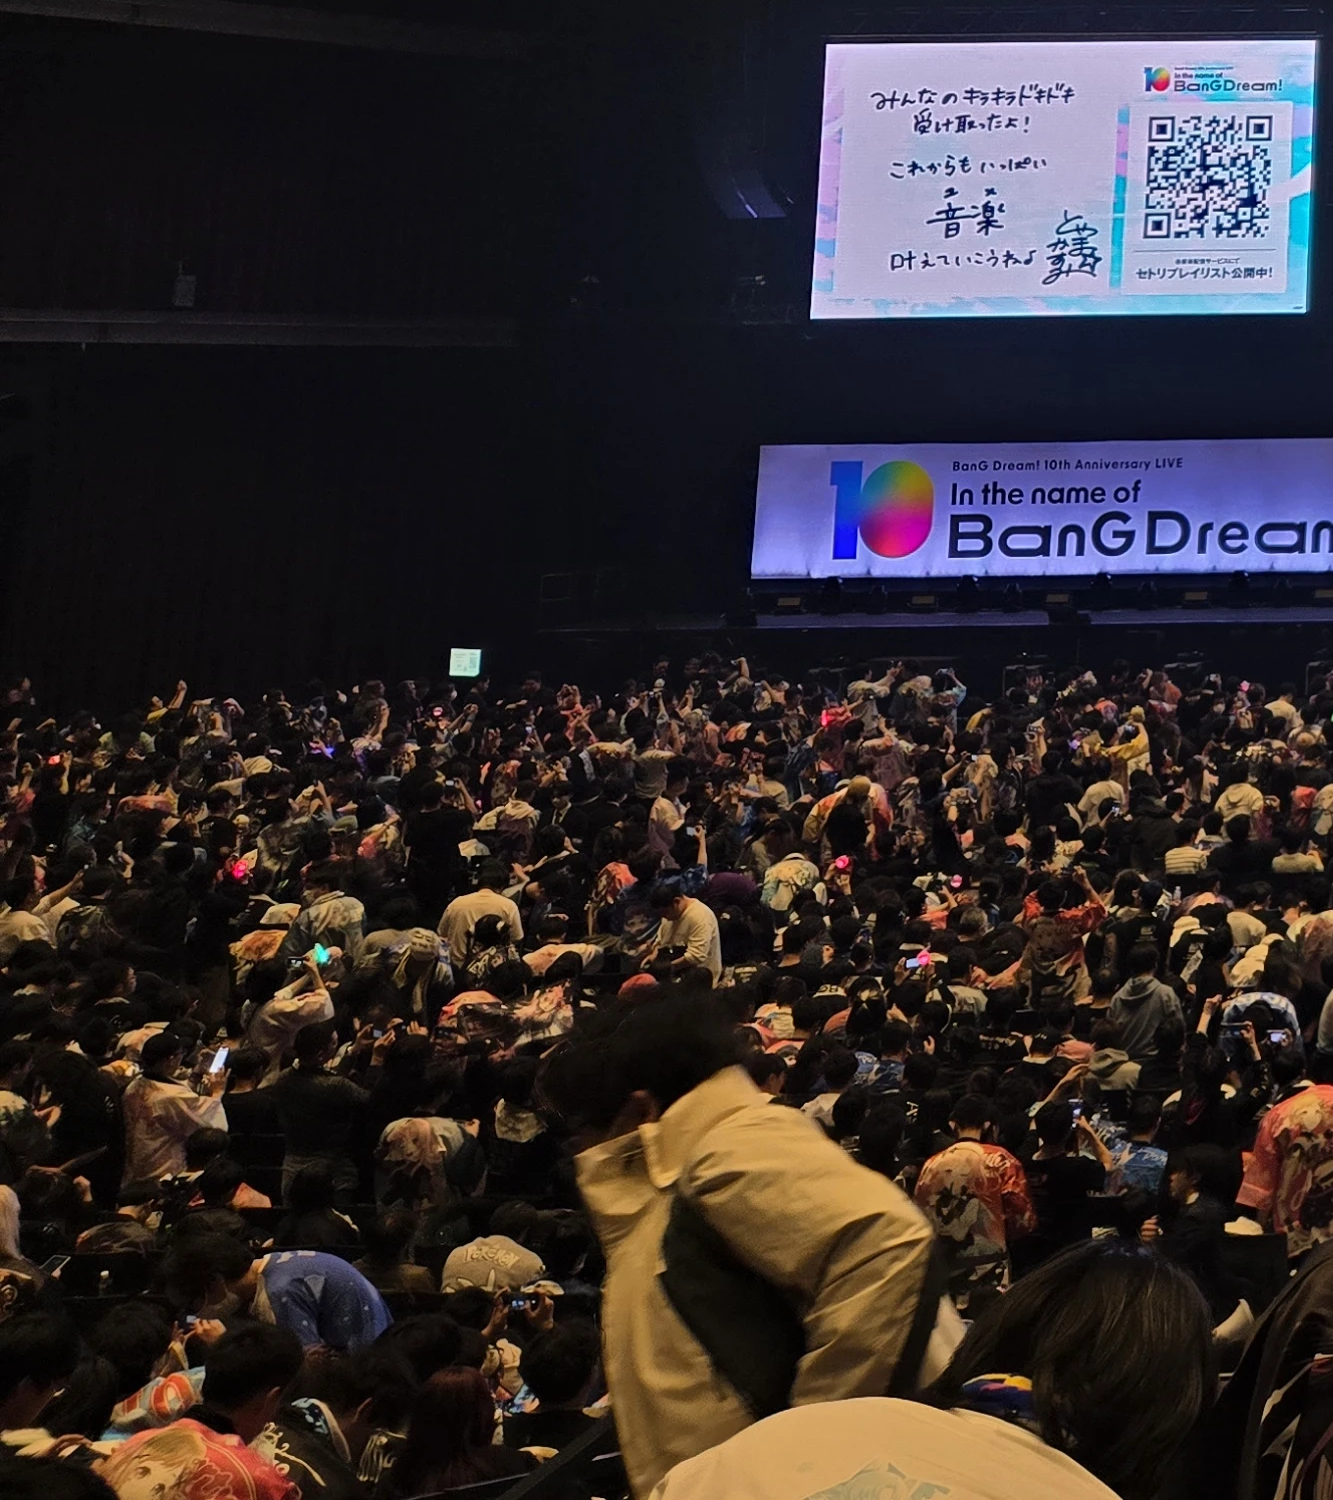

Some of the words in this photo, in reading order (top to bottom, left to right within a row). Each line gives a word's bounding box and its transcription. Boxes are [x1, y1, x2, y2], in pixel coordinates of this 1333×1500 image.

[952, 460, 989, 472] BanG
[992, 459, 1040, 471] Dream!
[1044, 459, 1071, 471] 10th
[1074, 458, 1151, 471] Anniversary
[1155, 457, 1183, 469] LIVE
[951, 482, 974, 506] In
[981, 480, 1025, 506] the
[1031, 486, 1107, 505] name
[1113, 478, 1142, 504] of
